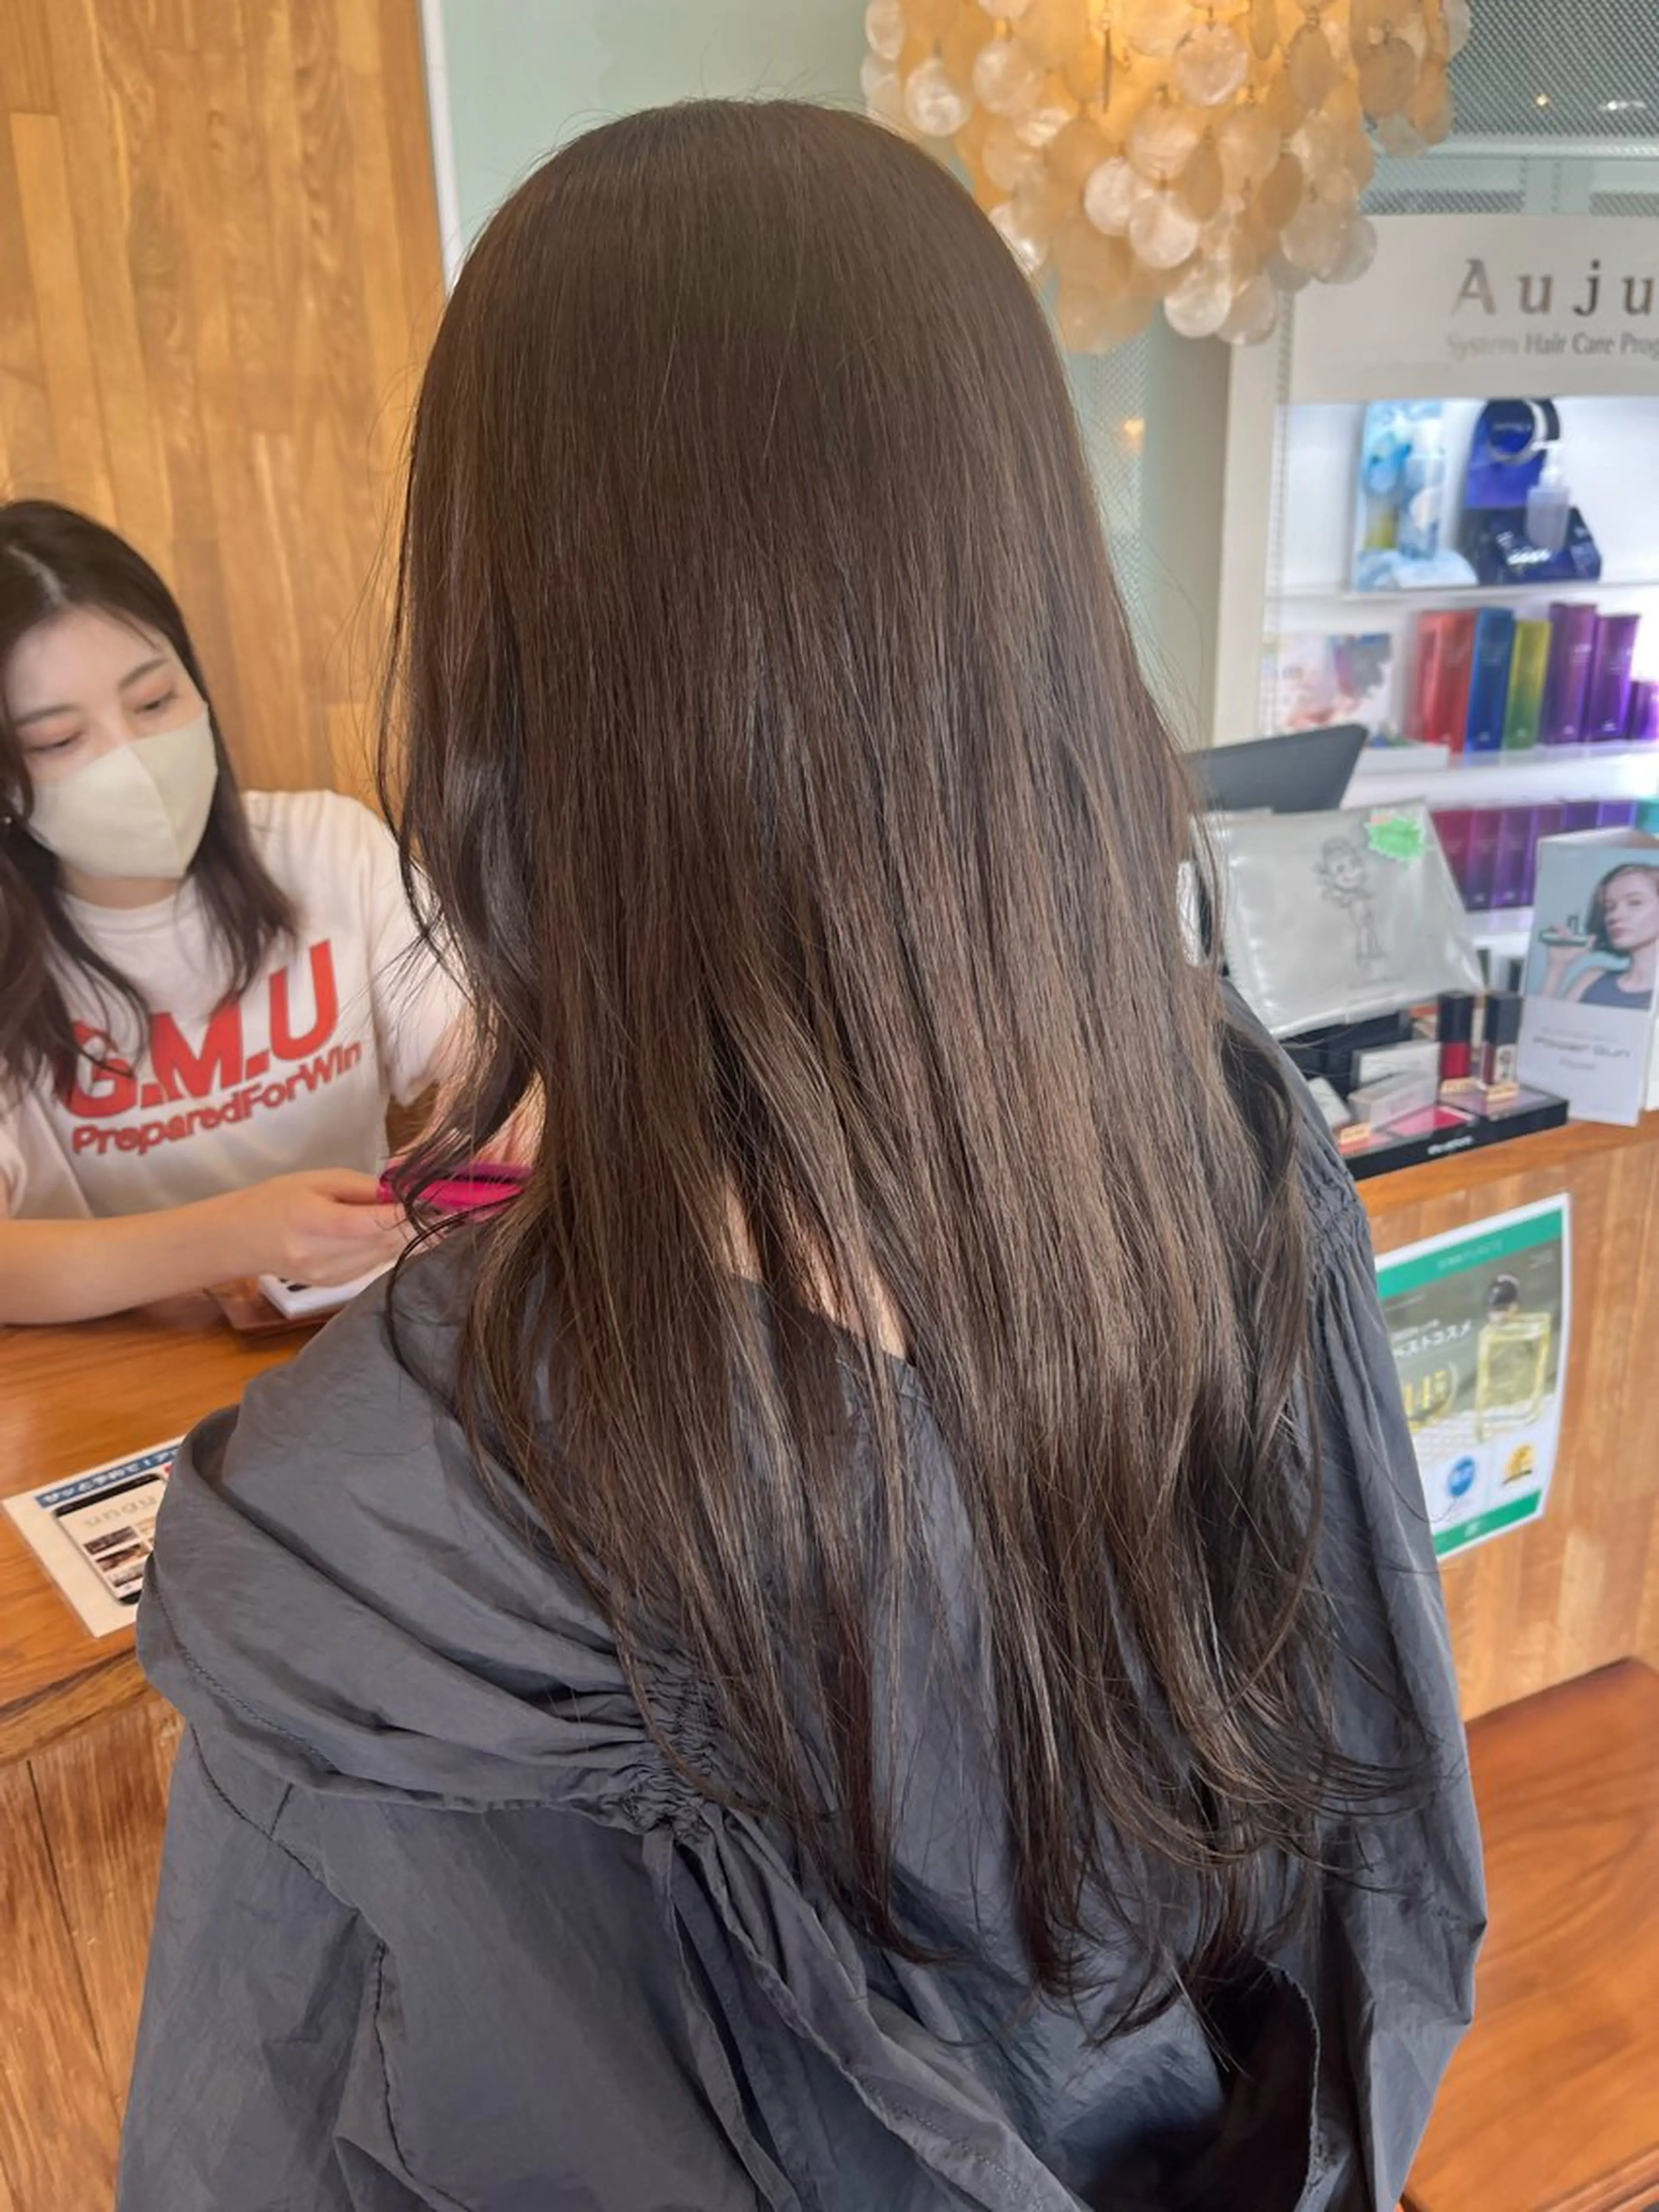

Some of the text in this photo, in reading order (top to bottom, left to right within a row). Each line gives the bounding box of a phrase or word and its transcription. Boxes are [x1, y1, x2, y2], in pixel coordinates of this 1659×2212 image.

[1451, 258, 1654, 317] Auju
[1525, 332, 1567, 355] Hair
[1571, 332, 1615, 355] Care
[72, 1041, 361, 1155] PreparedForWin
